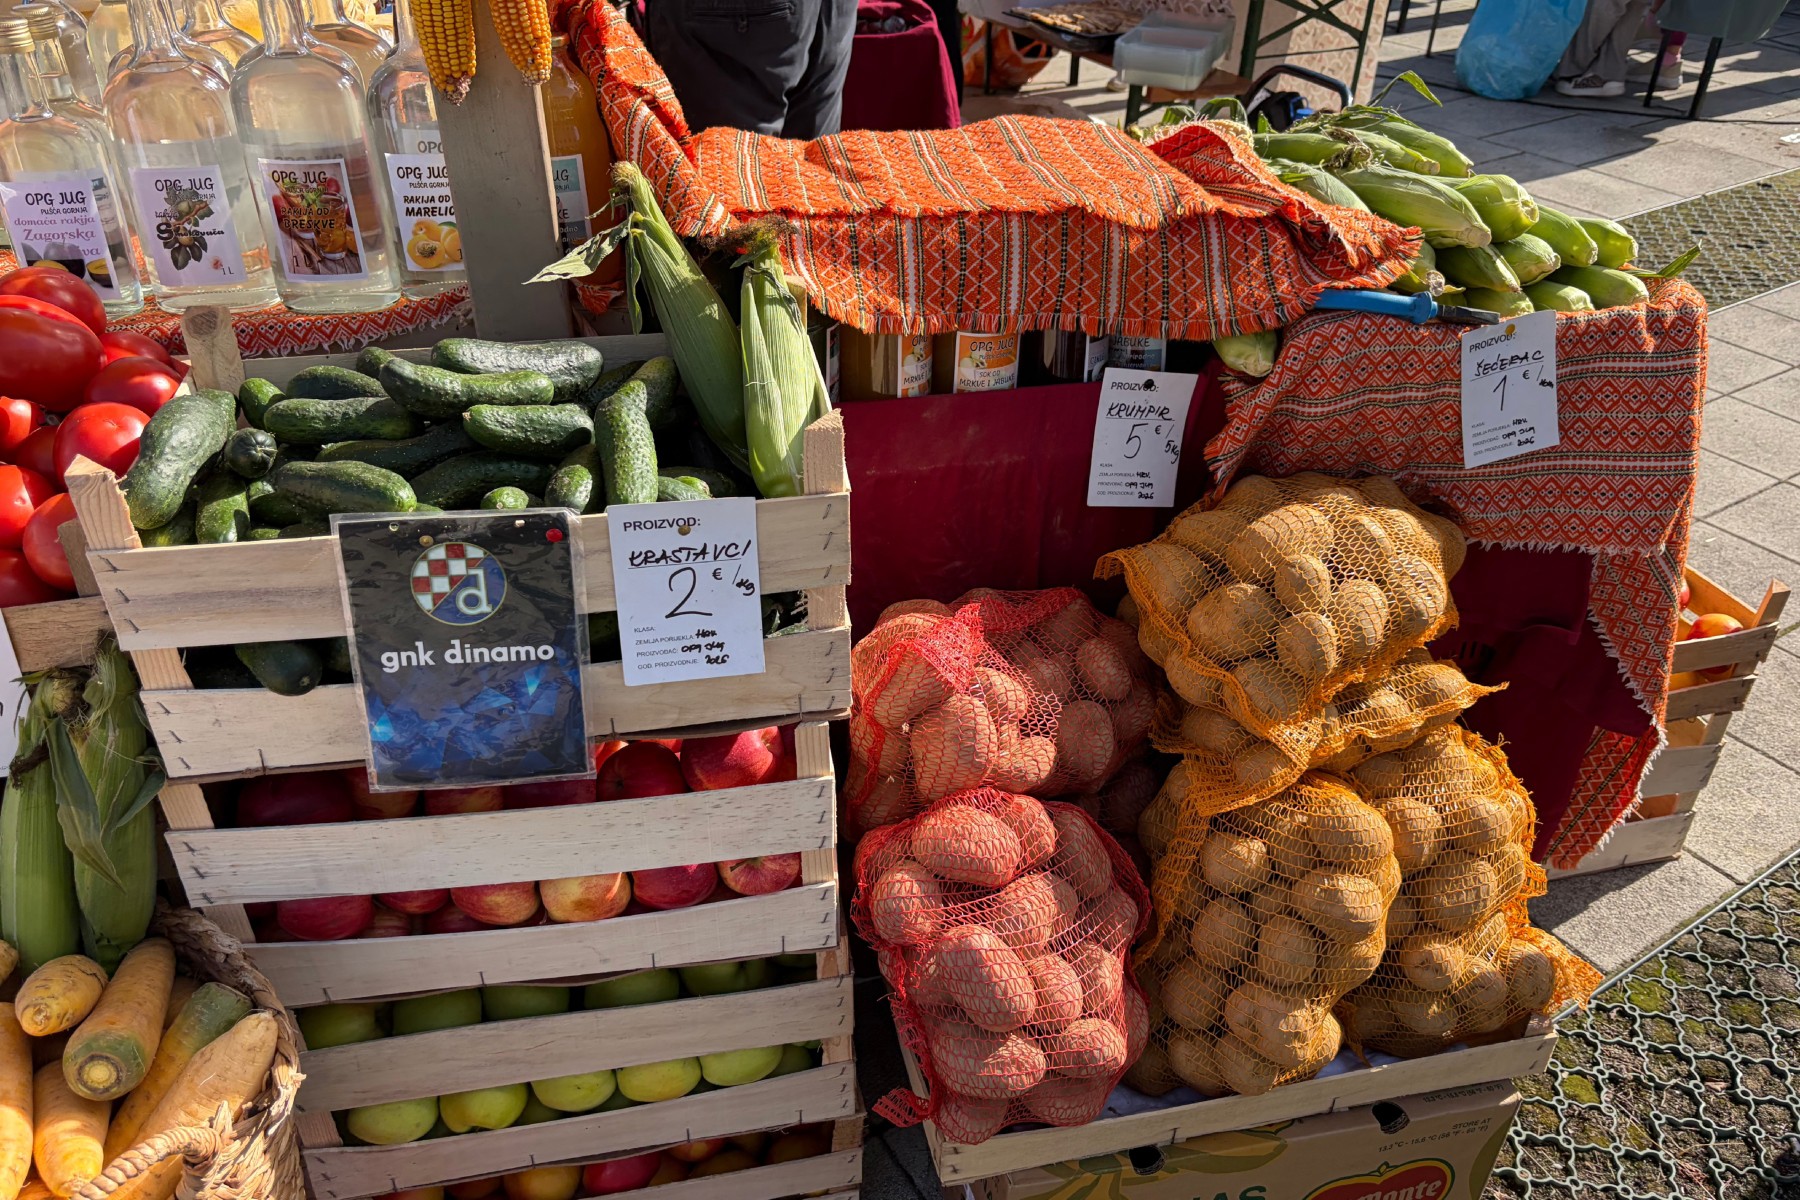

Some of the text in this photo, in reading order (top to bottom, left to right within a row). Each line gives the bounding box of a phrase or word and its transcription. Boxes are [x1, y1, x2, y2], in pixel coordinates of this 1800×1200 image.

[272, 170, 328, 184] OPG JUG
[397, 166, 423, 180] OPG
[154, 177, 215, 191] OPG JUG
[25, 192, 55, 207] OPG
[59, 190, 87, 205] JUG
[403, 195, 450, 204] RAKIJA OD
[62, 206, 88, 214] GORNJA
[281, 207, 330, 216] RAKIJA OD
[405, 206, 455, 217] MARELIC
[14, 215, 95, 226] domaća rakija
[284, 218, 335, 229] BRESKVE
[23, 228, 96, 242] Zagorska
[969, 337, 1014, 352] OPG JUG
[1113, 336, 1151, 347] JABUKE
[960, 378, 985, 388] MRKVE
[992, 373, 1015, 387] JABUKE
[1492, 374, 1507, 411] 1
[1522, 369, 1530, 380] €
[1106, 402, 1172, 420] KRUMPIR
[1124, 423, 1148, 459] 5
[1154, 424, 1162, 435] €
[623, 517, 701, 531] PROIZVOD:
[629, 540, 751, 567] KRASTAVCI
[665, 567, 713, 618] 2
[712, 568, 723, 580] €
[381, 640, 555, 673] gnk dinamo
[1452, 1119, 1480, 1130] STORE
[1378, 1145, 1393, 1153] 13.3
